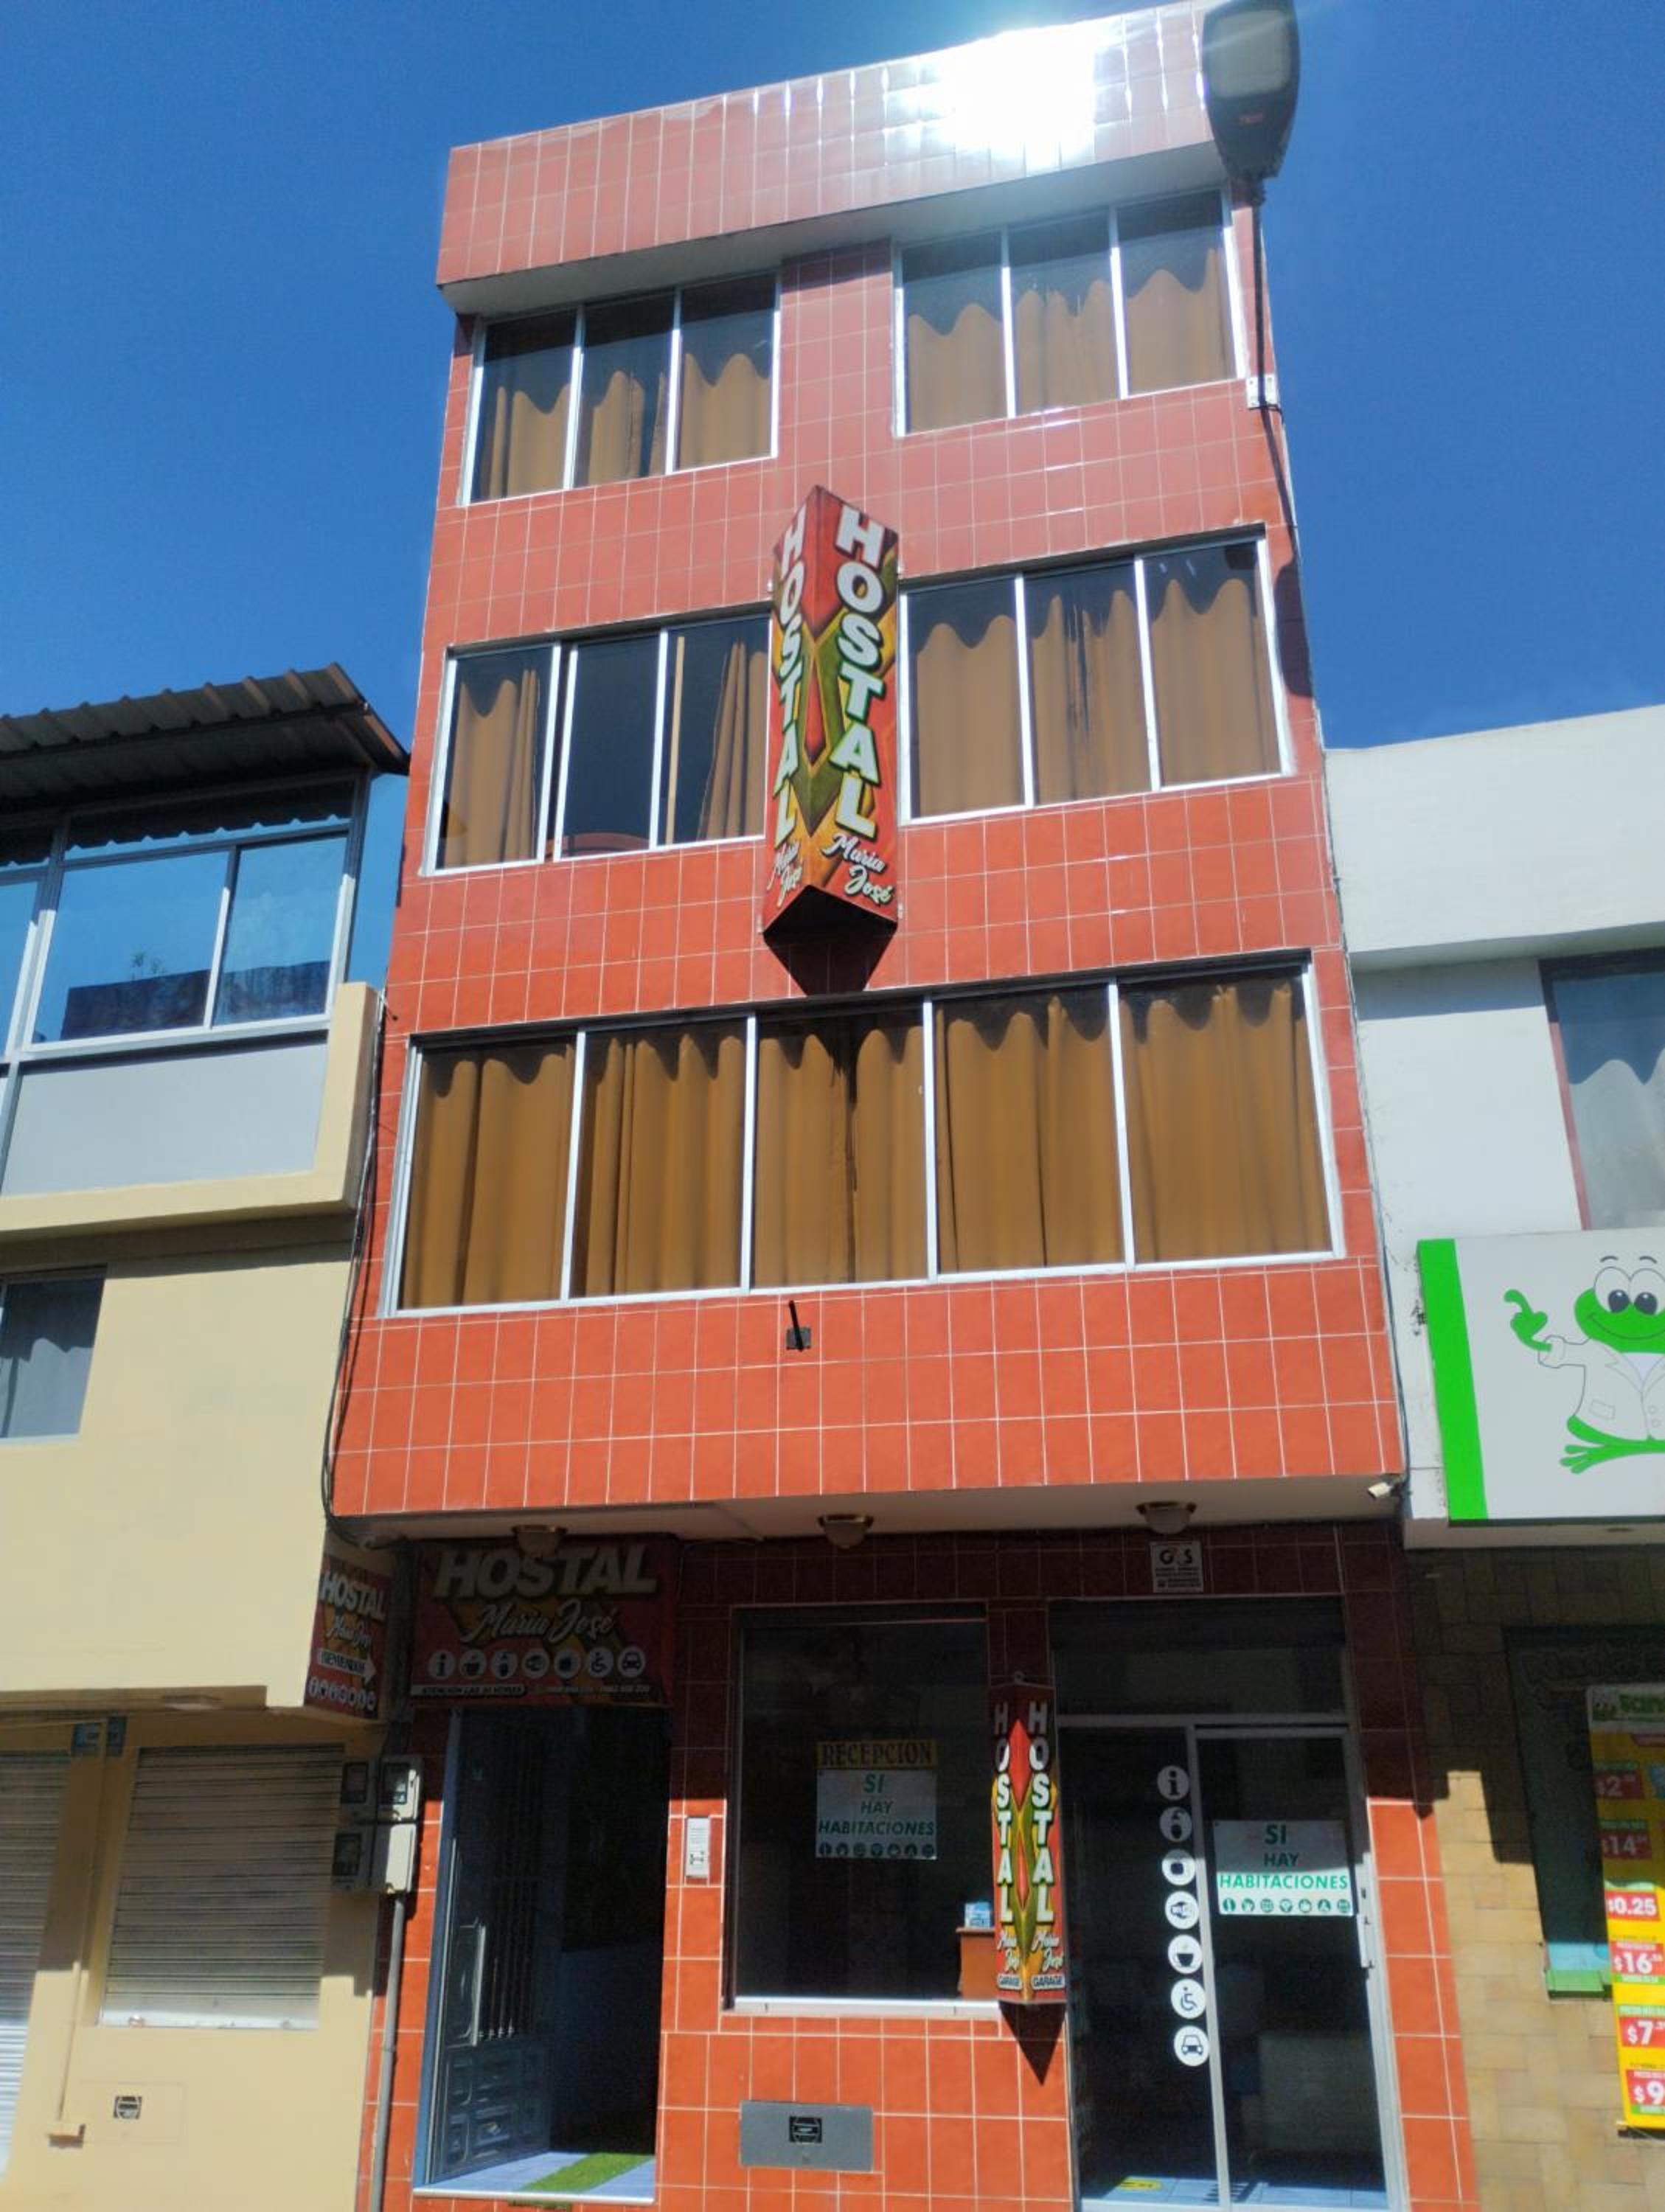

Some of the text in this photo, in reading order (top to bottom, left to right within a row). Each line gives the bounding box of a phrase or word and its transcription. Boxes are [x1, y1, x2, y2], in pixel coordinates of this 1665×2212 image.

[772, 504, 805, 848] HOSTAL
[829, 505, 883, 839] HOSTAL
[844, 864, 894, 905] José
[434, 1545, 658, 1599] HOSTAL
[321, 1571, 386, 1621] HOSTAL
[549, 1598, 617, 1643] José
[863, 1773, 886, 1793] SI
[818, 1820, 934, 1835] HABITACIONES
[861, 1801, 894, 1814] HAY
[994, 1703, 1012, 1922] HOSTAL
[1028, 1702, 1054, 1922] HOSTAL
[1265, 1824, 1287, 1845] SI
[1263, 1852, 1299, 1867] HAY
[1220, 1875, 1347, 1889] HABITACIONES
